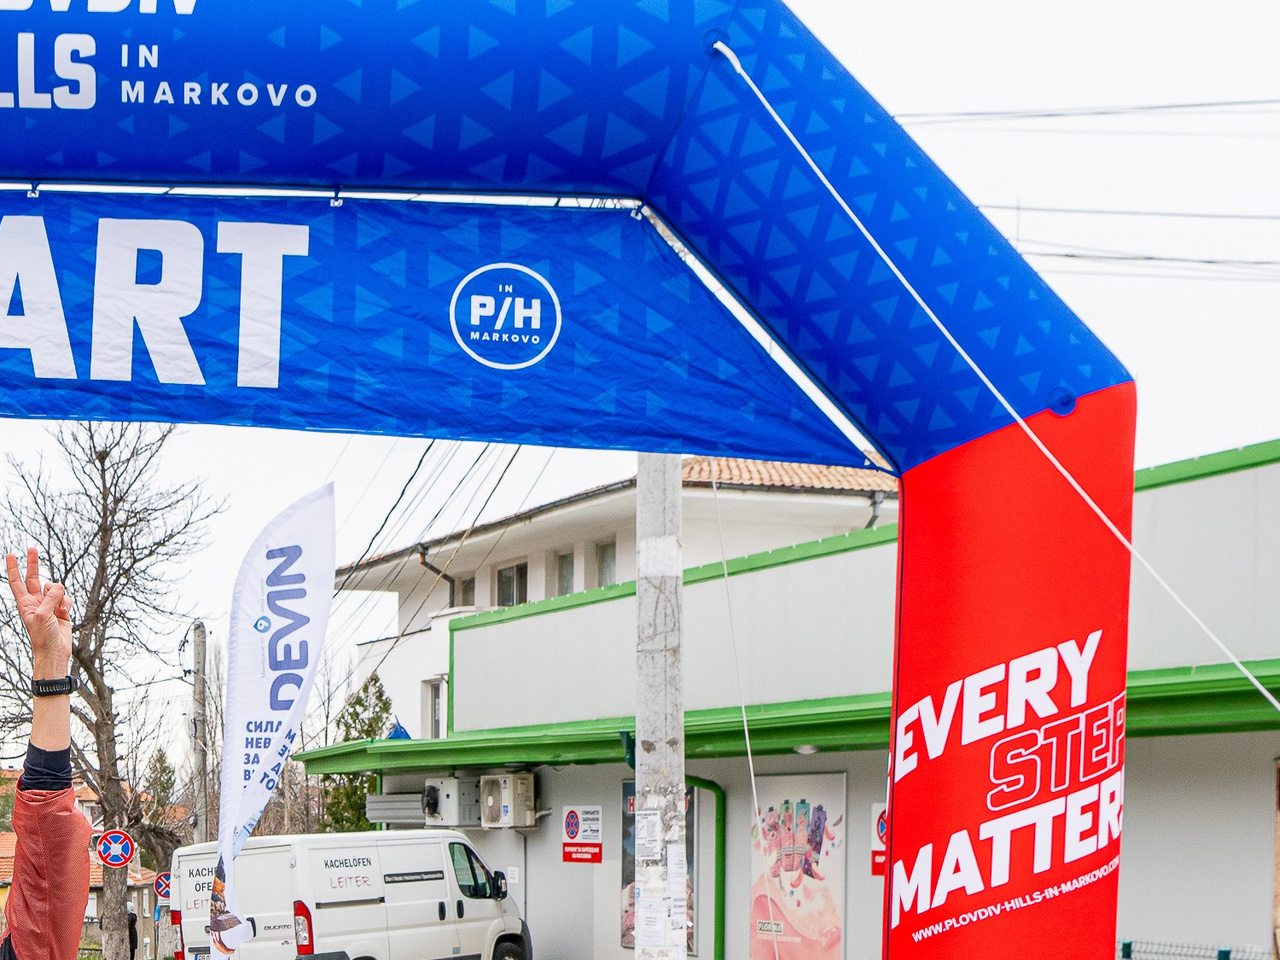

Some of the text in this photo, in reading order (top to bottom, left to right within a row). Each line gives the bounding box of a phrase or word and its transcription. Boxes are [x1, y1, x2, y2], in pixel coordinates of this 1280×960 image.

[121, 44, 158, 68] IN
[121, 81, 318, 108] MARKOVO
[498, 284, 513, 293] IN
[470, 294, 541, 330] P/H
[470, 331, 540, 344] MARKOVO
[265, 544, 311, 711] DEVIN
[894, 629, 1104, 784] EVERY
[891, 768, 1125, 930] MATTER
[324, 856, 372, 868] KACHELÖFEN
[194, 881, 213, 892] ÖFE
[330, 875, 372, 889] LEITER
